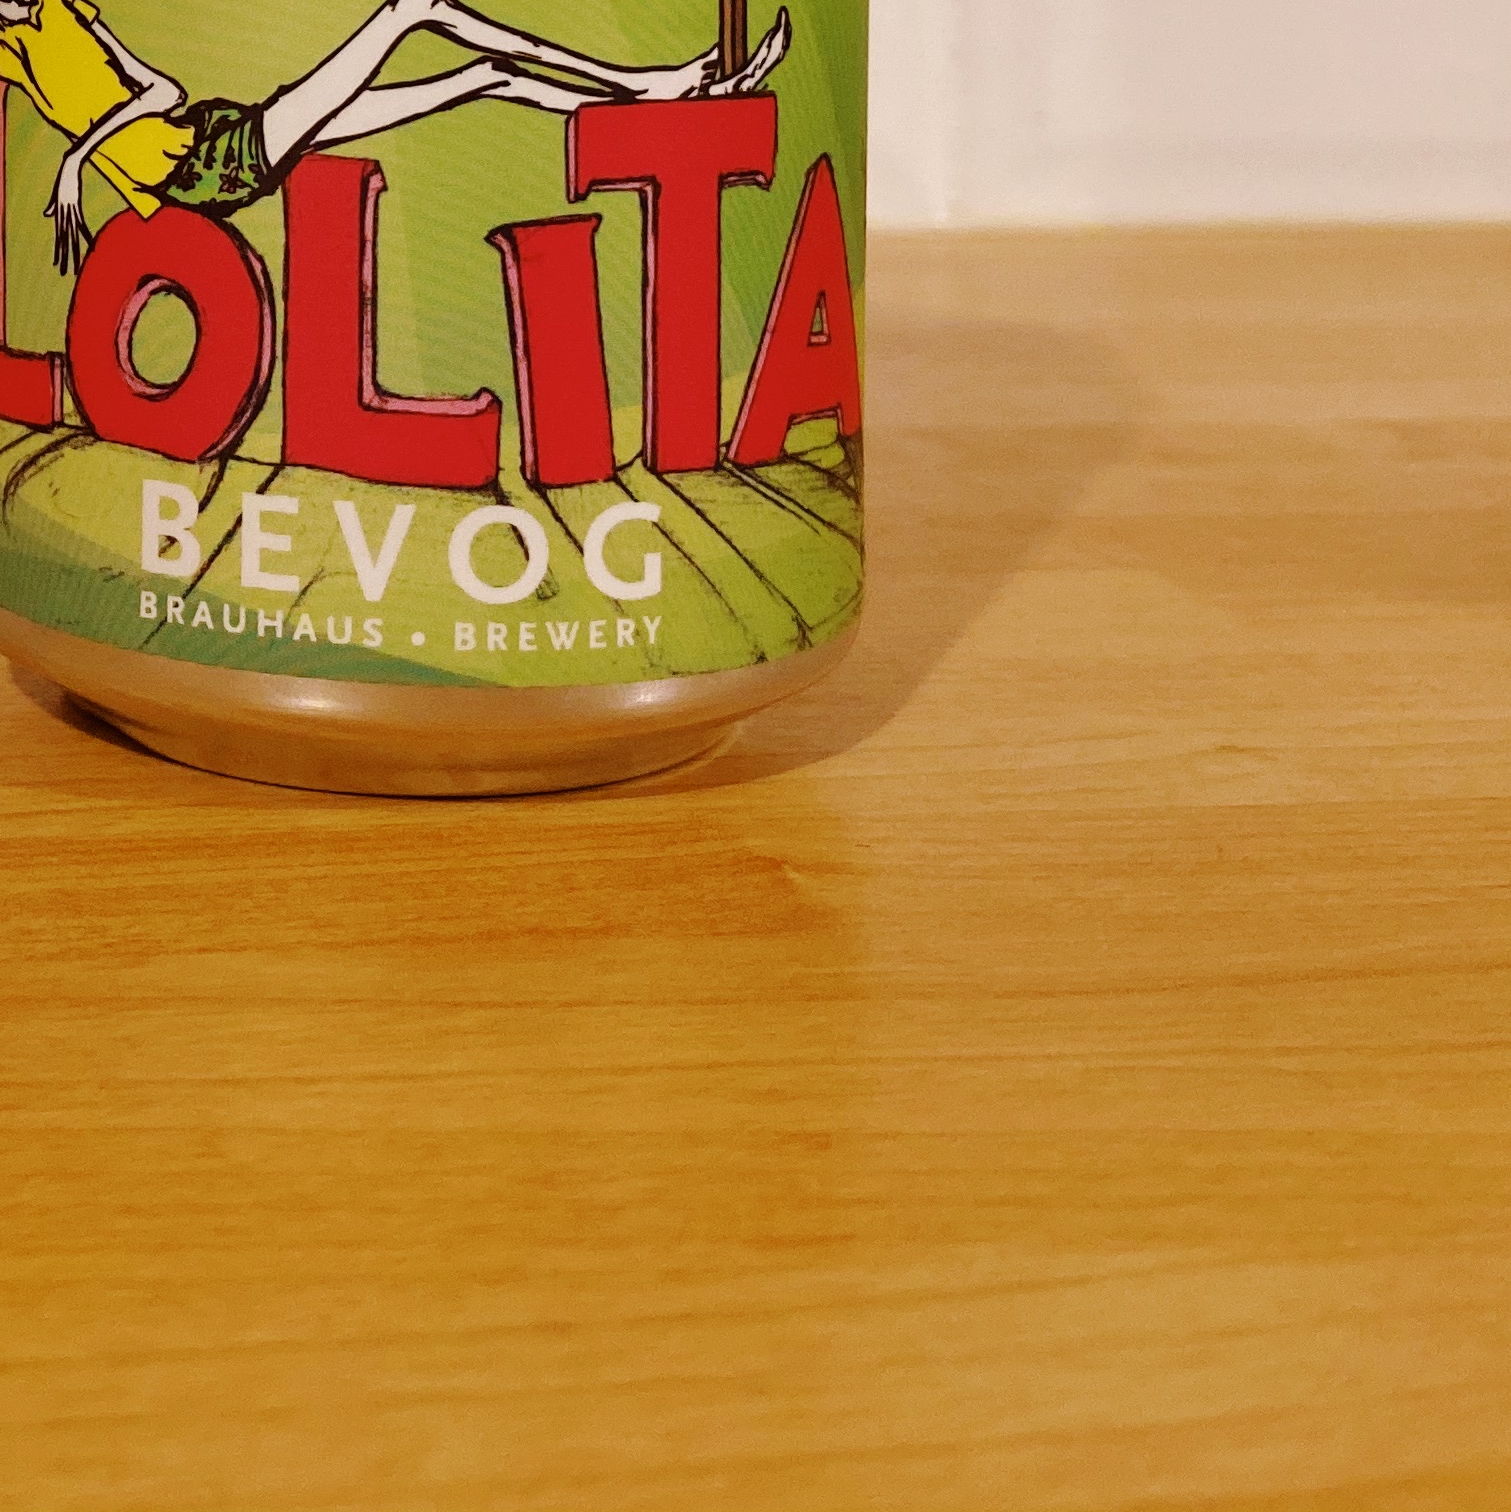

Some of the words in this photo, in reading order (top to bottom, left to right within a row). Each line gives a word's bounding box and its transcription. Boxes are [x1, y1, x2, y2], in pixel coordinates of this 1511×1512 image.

[140, 478, 664, 605] BEVOG
[138, 590, 384, 647] BRAUHAUS
[454, 616, 663, 652] BREWERY
